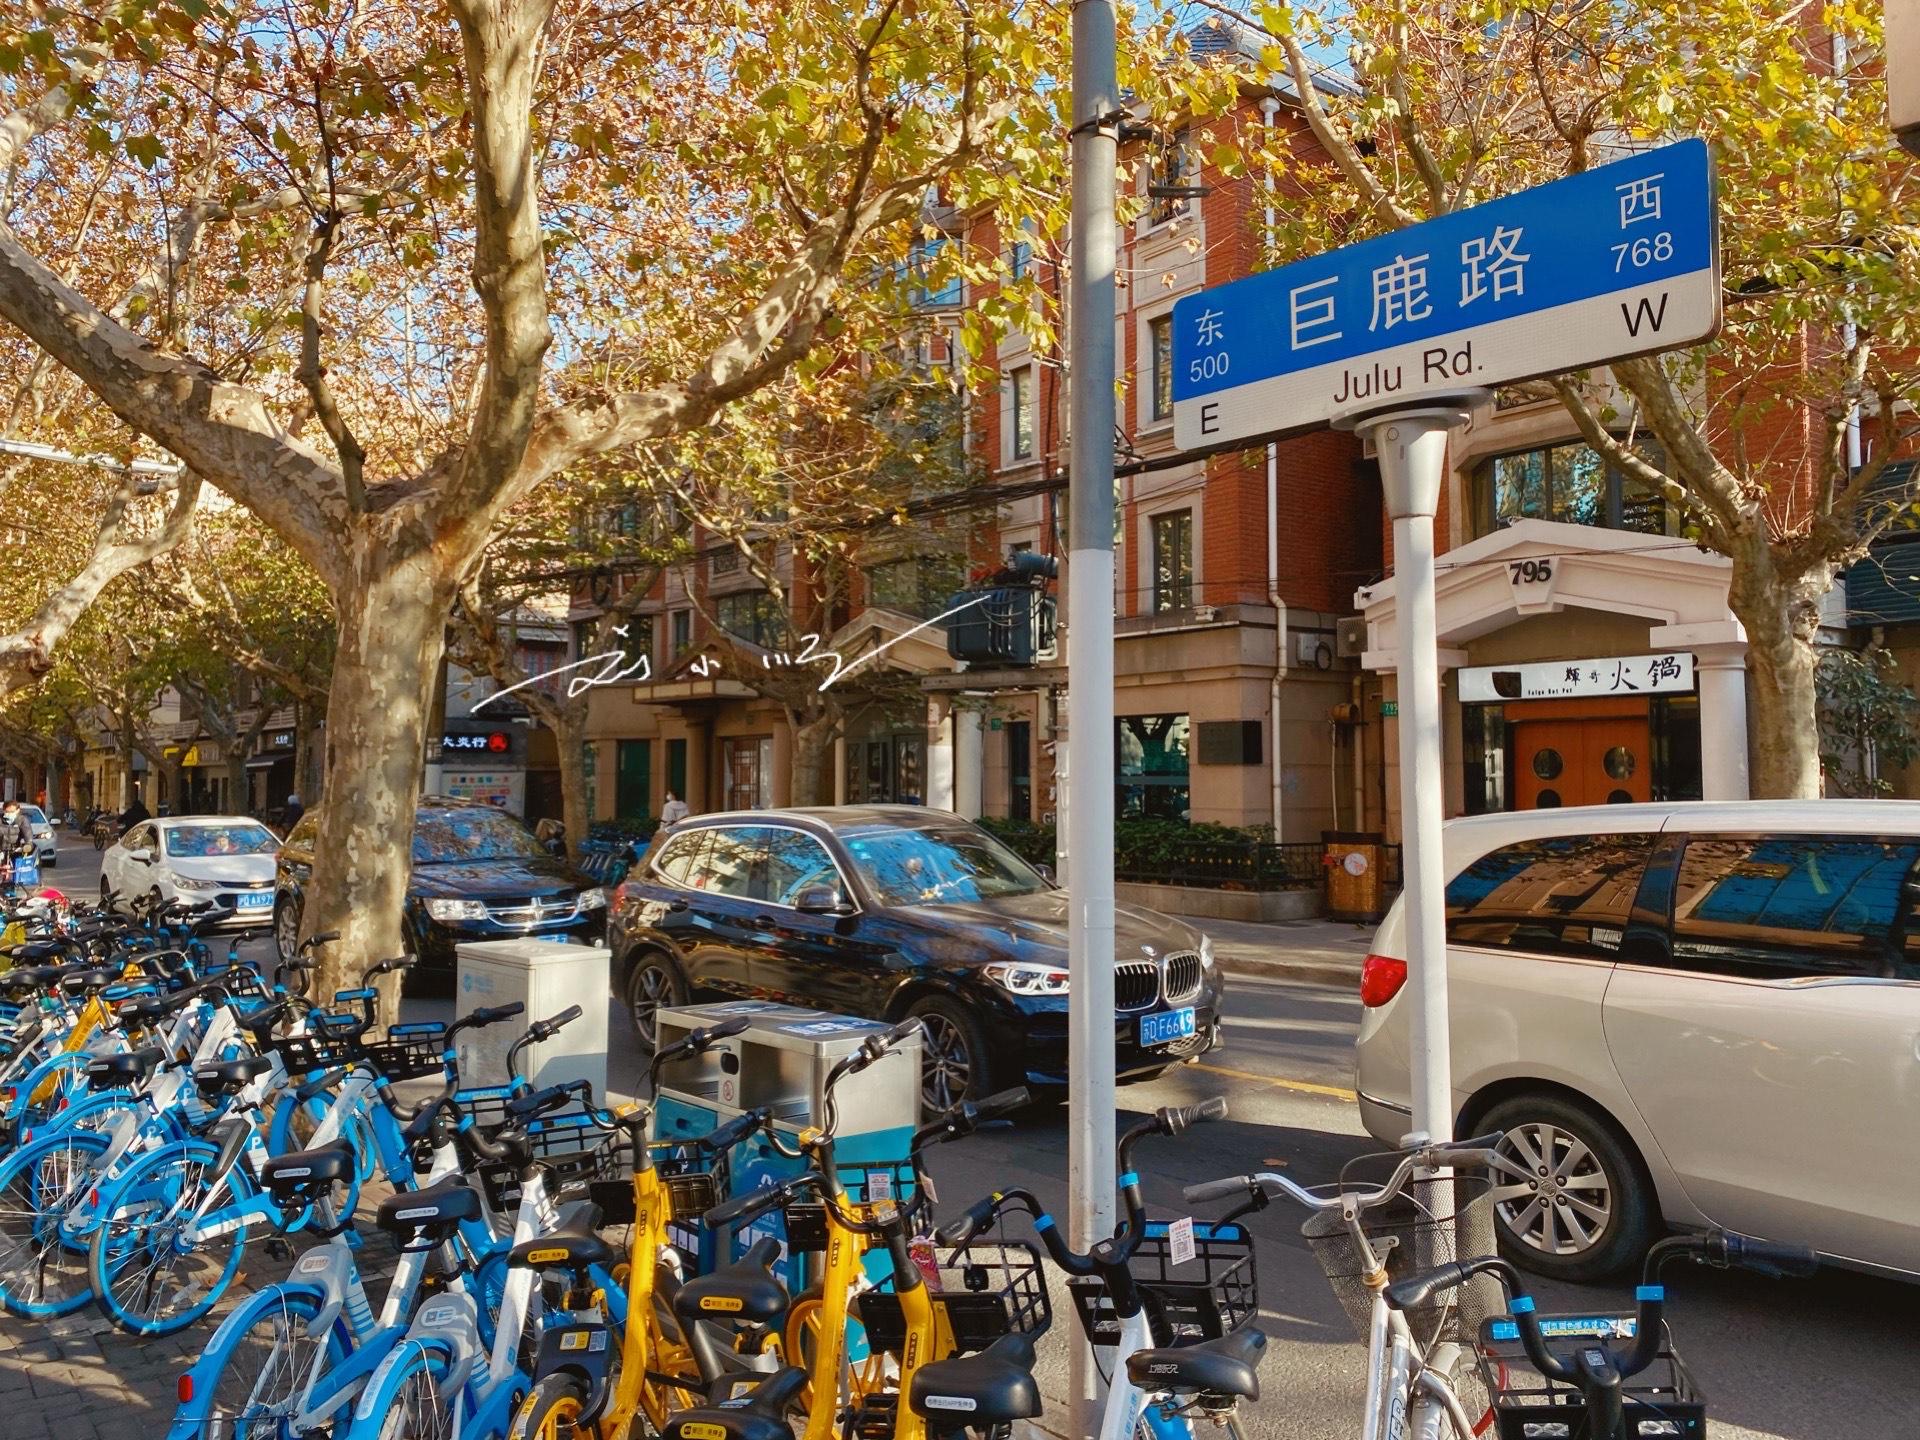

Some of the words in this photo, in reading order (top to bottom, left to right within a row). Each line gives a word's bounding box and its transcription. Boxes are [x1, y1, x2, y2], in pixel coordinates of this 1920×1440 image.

[1615, 173, 1666, 230] 西
[1611, 232, 1674, 273] 768
[1290, 225, 1531, 351] 巨鹿路
[1195, 308, 1225, 347] 东
[1620, 293, 1669, 337] W
[1189, 351, 1230, 383] 500
[1333, 363, 1403, 404] Julu
[1423, 341, 1484, 383] Rd.
[1200, 402, 1220, 435] E
[1508, 559, 1553, 585] 795
